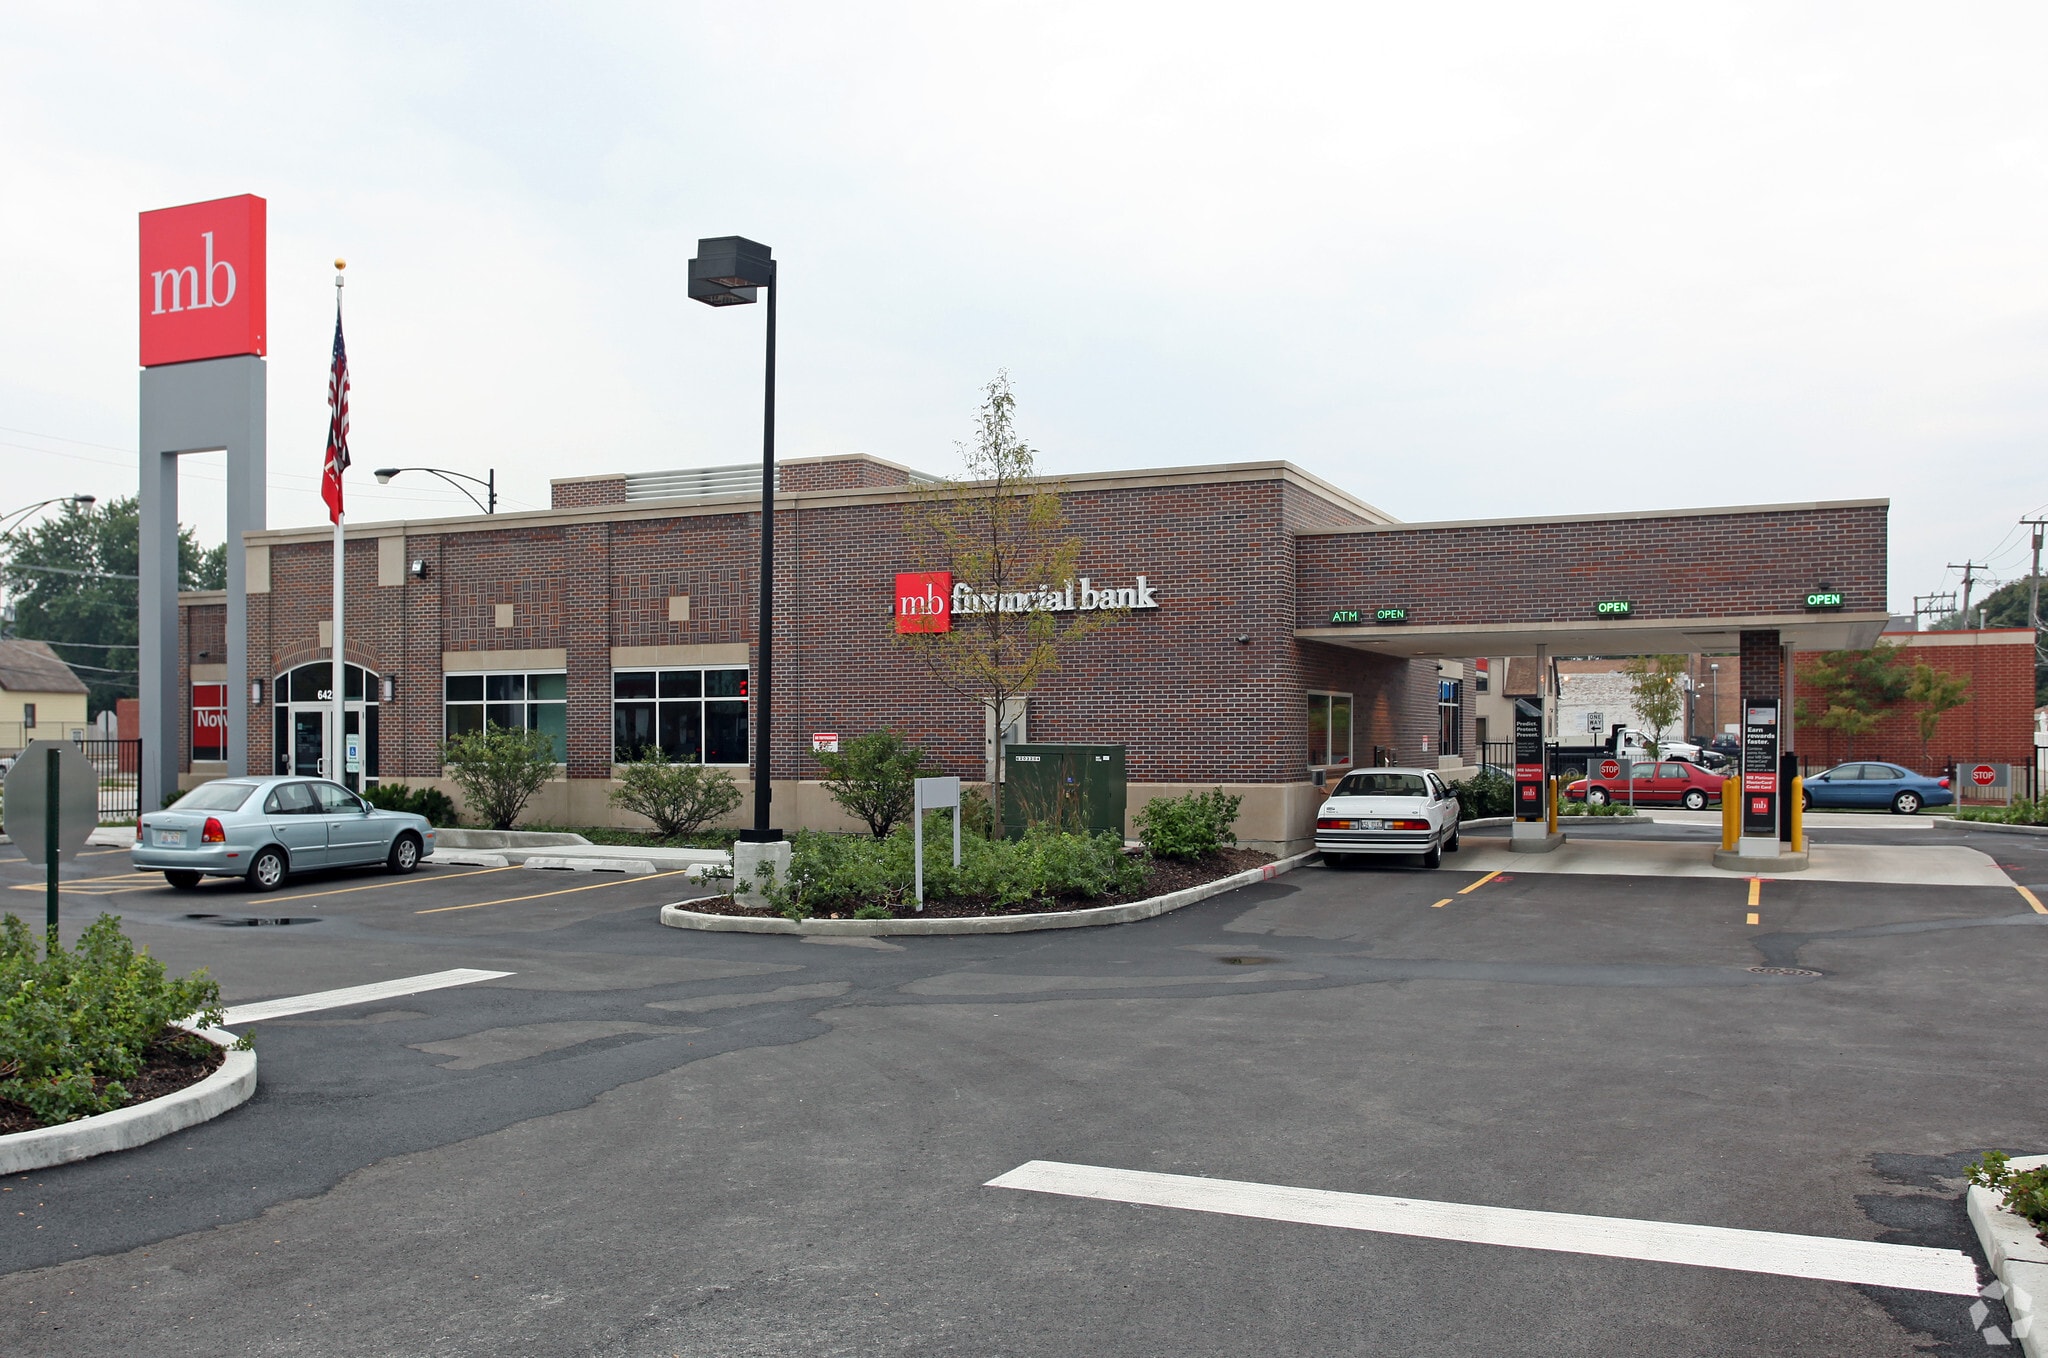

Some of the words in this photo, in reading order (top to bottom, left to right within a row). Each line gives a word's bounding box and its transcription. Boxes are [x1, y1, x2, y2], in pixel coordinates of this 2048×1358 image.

[151, 231, 236, 315] mb
[901, 583, 944, 615] mb
[1080, 576, 1159, 611] bank
[1807, 594, 1840, 605] OPEN
[1598, 602, 1628, 613] OPEN
[1332, 611, 1358, 622] ATM
[1377, 609, 1404, 619] OPEN
[317, 689, 333, 700] 642
[1601, 765, 1619, 774] STOP
[1973, 771, 1994, 780] STOP
[1753, 800, 1766, 809] mb
